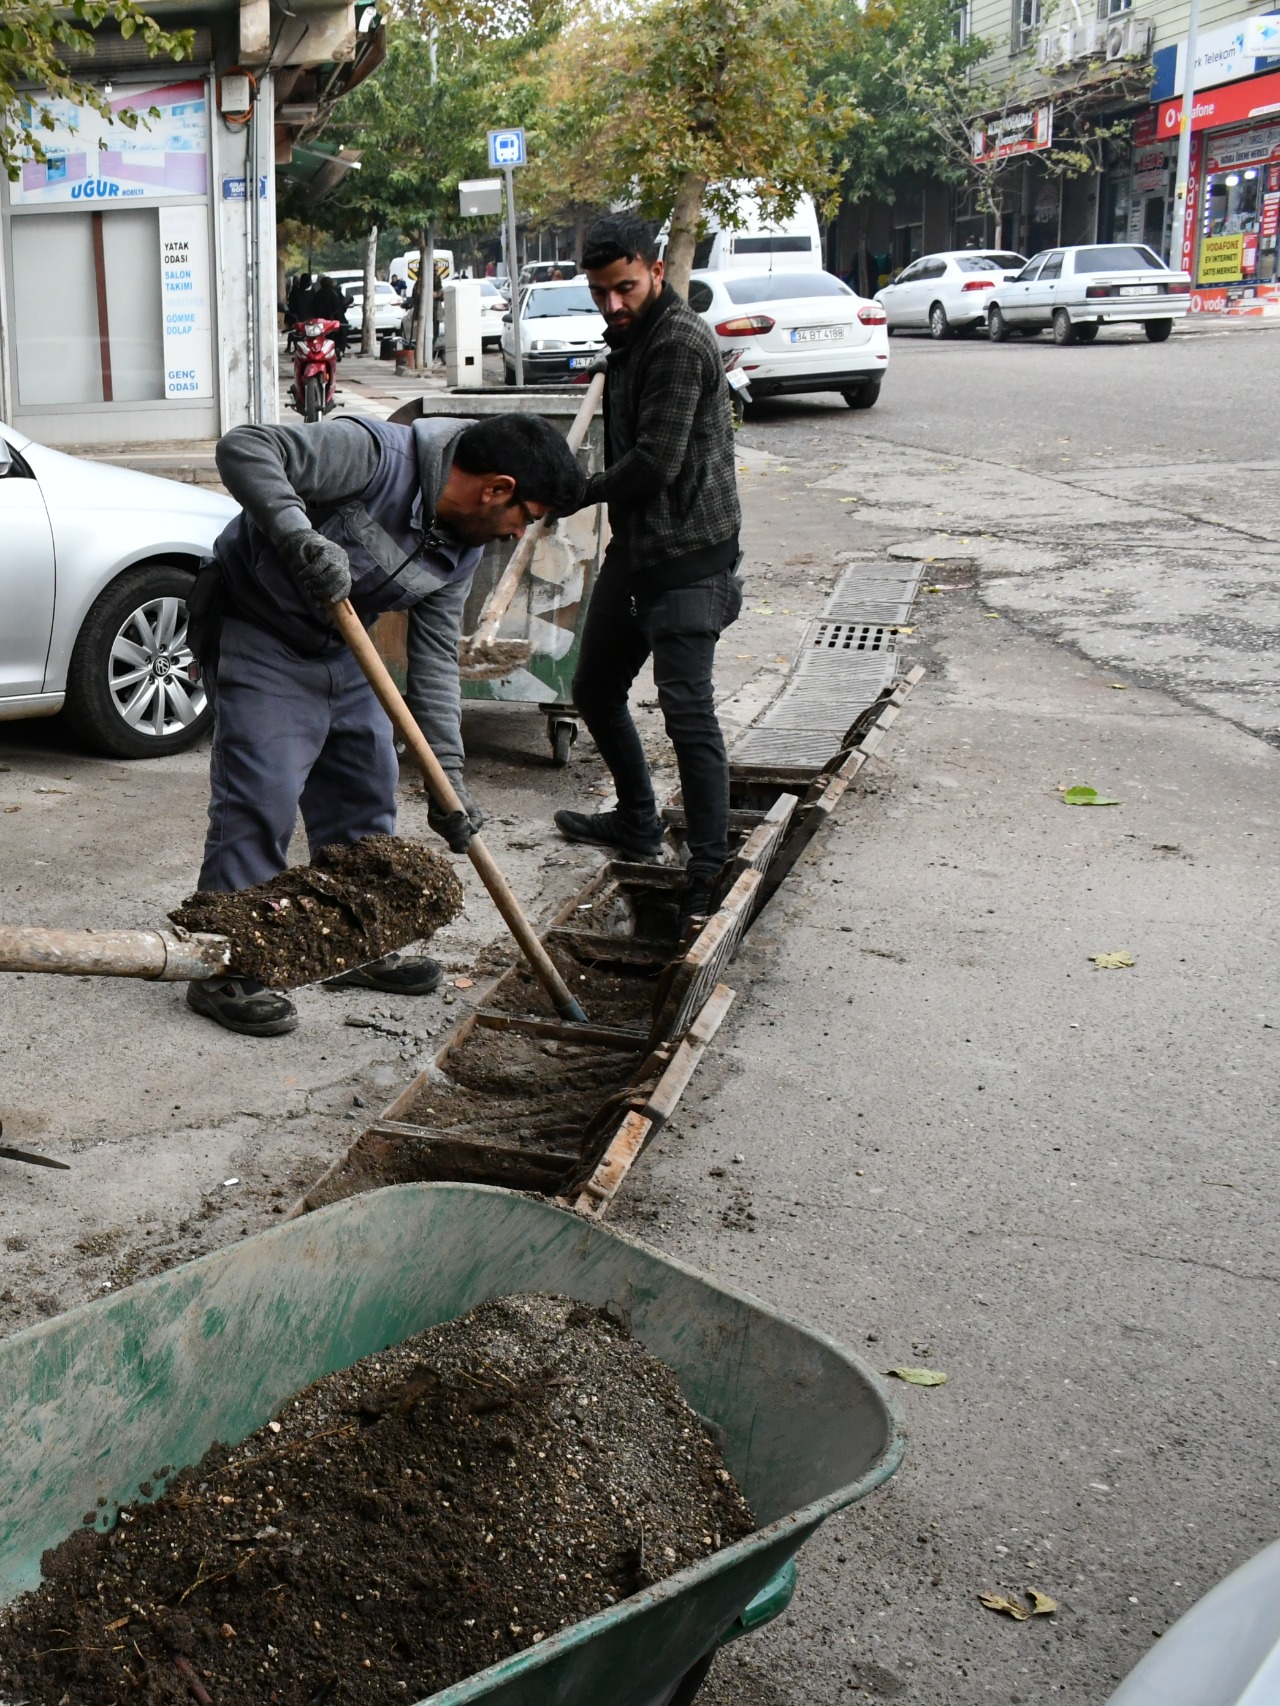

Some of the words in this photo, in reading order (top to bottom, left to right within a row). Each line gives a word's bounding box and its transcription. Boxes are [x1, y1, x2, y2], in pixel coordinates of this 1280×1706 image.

[1204, 48, 1236, 65] Telekom
[1177, 103, 1215, 122] vafone
[70, 174, 120, 199] UĞUR
[122, 188, 144, 197] MOBİLYA
[1181, 160, 1197, 269] vodafon
[164, 242, 189, 251] YATAK
[1206, 240, 1240, 251] VODAFONE
[164, 255, 188, 264] ODASI
[1205, 255, 1212, 264] EV
[165, 270, 191, 280] SALON
[165, 282, 193, 291] TAKIMI
[166, 313, 196, 323] GÖMME
[166, 326, 193, 335] DOLAP
[796, 331, 807, 341] 34
[810, 331, 821, 340] BT
[574, 358, 582, 366] 34
[168, 370, 196, 381] GENÇ
[168, 383, 199, 391] ODASI
